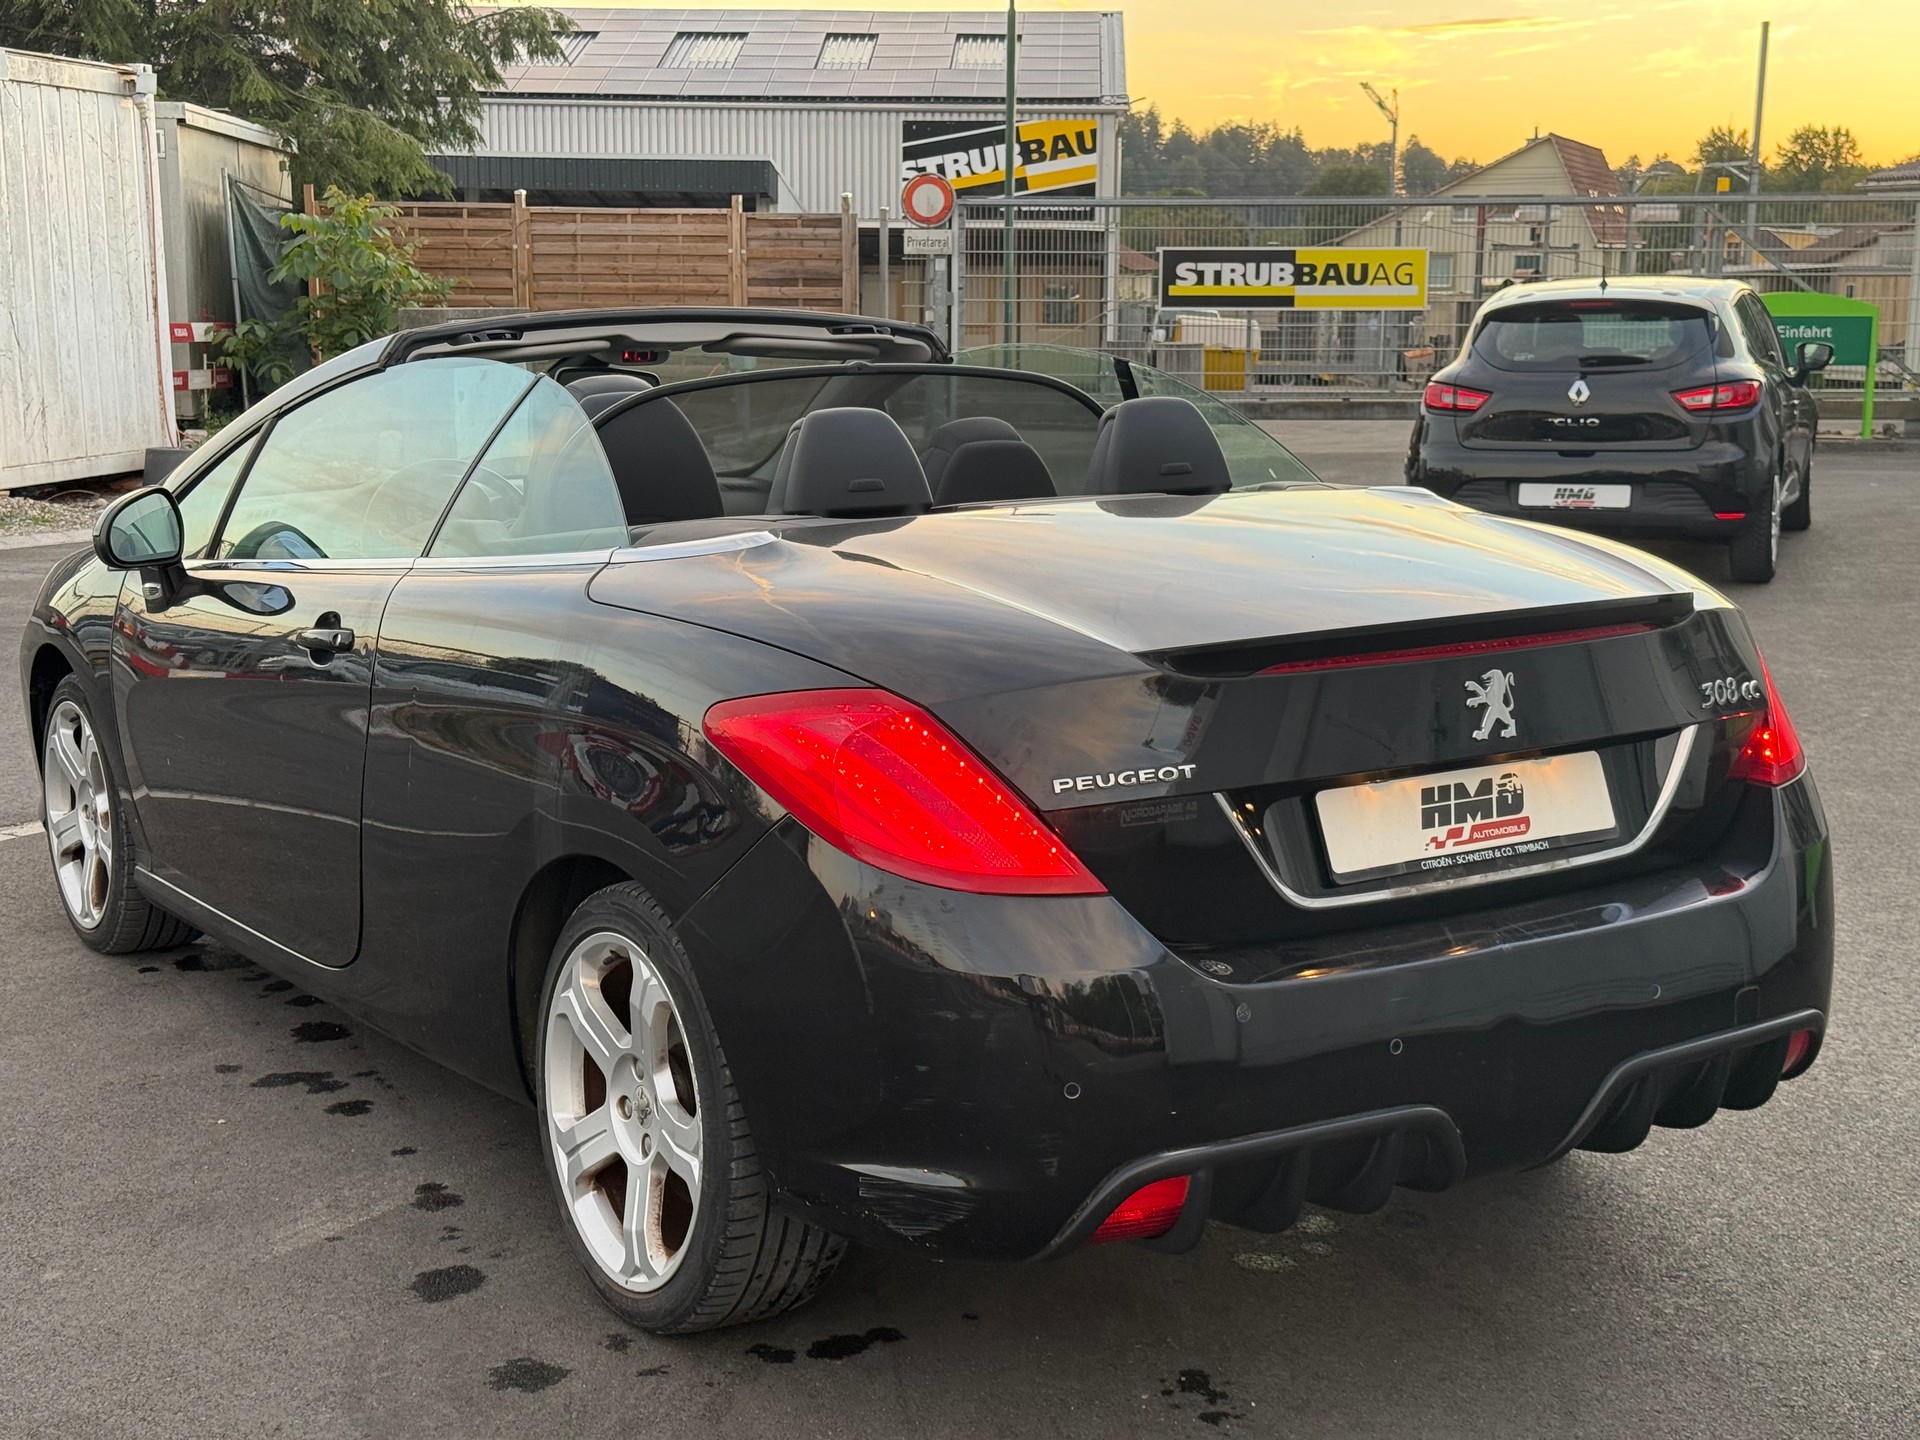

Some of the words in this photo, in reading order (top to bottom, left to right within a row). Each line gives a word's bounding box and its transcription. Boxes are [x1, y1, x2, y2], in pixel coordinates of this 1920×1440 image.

[907, 236, 950, 249] Privatareal
[1777, 325, 1832, 338] Einfahrt
[1553, 418, 1600, 427] CLIO
[1701, 677, 1739, 709] 308
[1053, 764, 1196, 794] PEUGEOT
[1473, 823, 1526, 839] AUTOMOBILE
[1457, 853, 1494, 864] SCHNEITER
[1495, 849, 1501, 858] &
[1501, 848, 1515, 857] CO.
[1516, 841, 1549, 853] TRIMBACH
